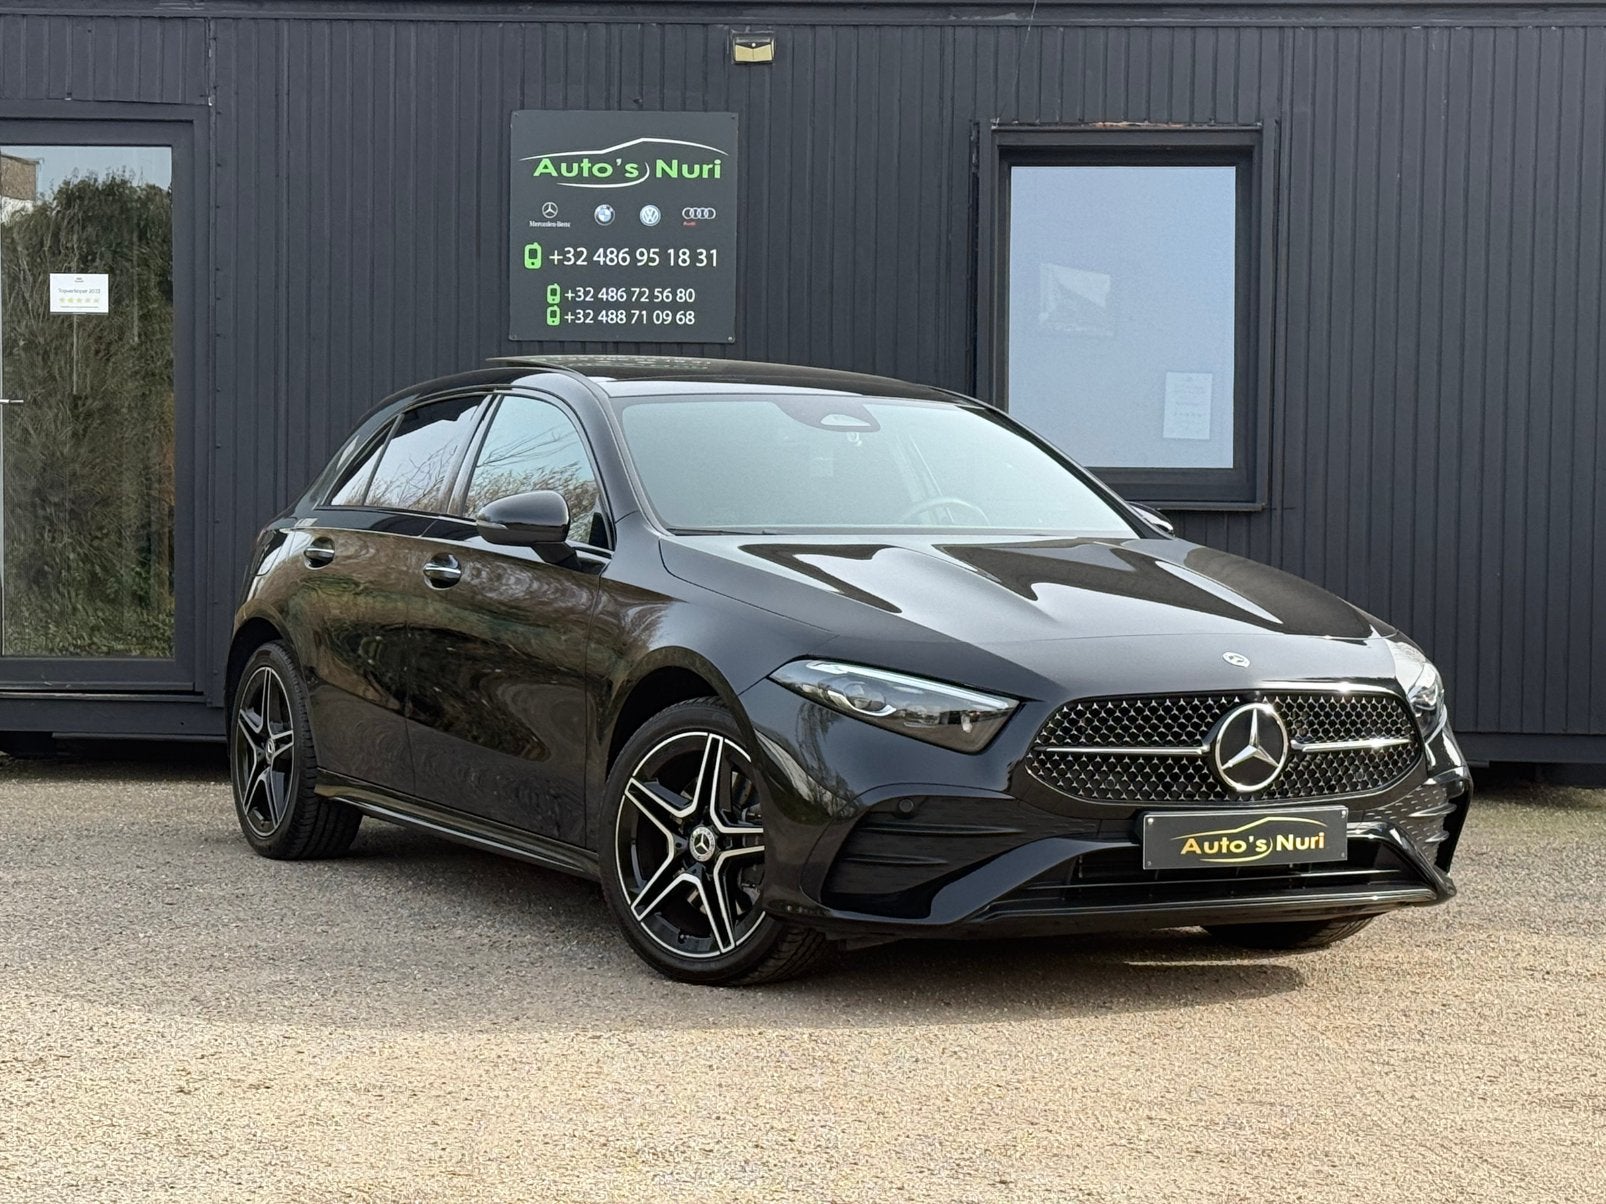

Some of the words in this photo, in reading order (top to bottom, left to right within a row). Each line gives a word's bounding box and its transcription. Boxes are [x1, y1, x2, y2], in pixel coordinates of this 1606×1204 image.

[533, 158, 639, 178] Auto's
[655, 159, 721, 179] Nuri
[549, 247, 588, 265] +32
[593, 247, 631, 266] 486
[635, 248, 660, 266] 95
[667, 248, 691, 267] 18
[695, 248, 718, 267] 31
[564, 287, 594, 302] +32
[597, 287, 627, 302] 486
[630, 288, 650, 302] 72
[653, 288, 673, 302] 56
[676, 288, 696, 303] 80
[564, 309, 594, 324] +32
[597, 310, 627, 324] 488
[630, 310, 648, 324] 71
[653, 310, 673, 325] 09
[675, 311, 696, 325] 68
[1180, 835, 1268, 855] Auto's
[1276, 832, 1325, 852] Nuri
